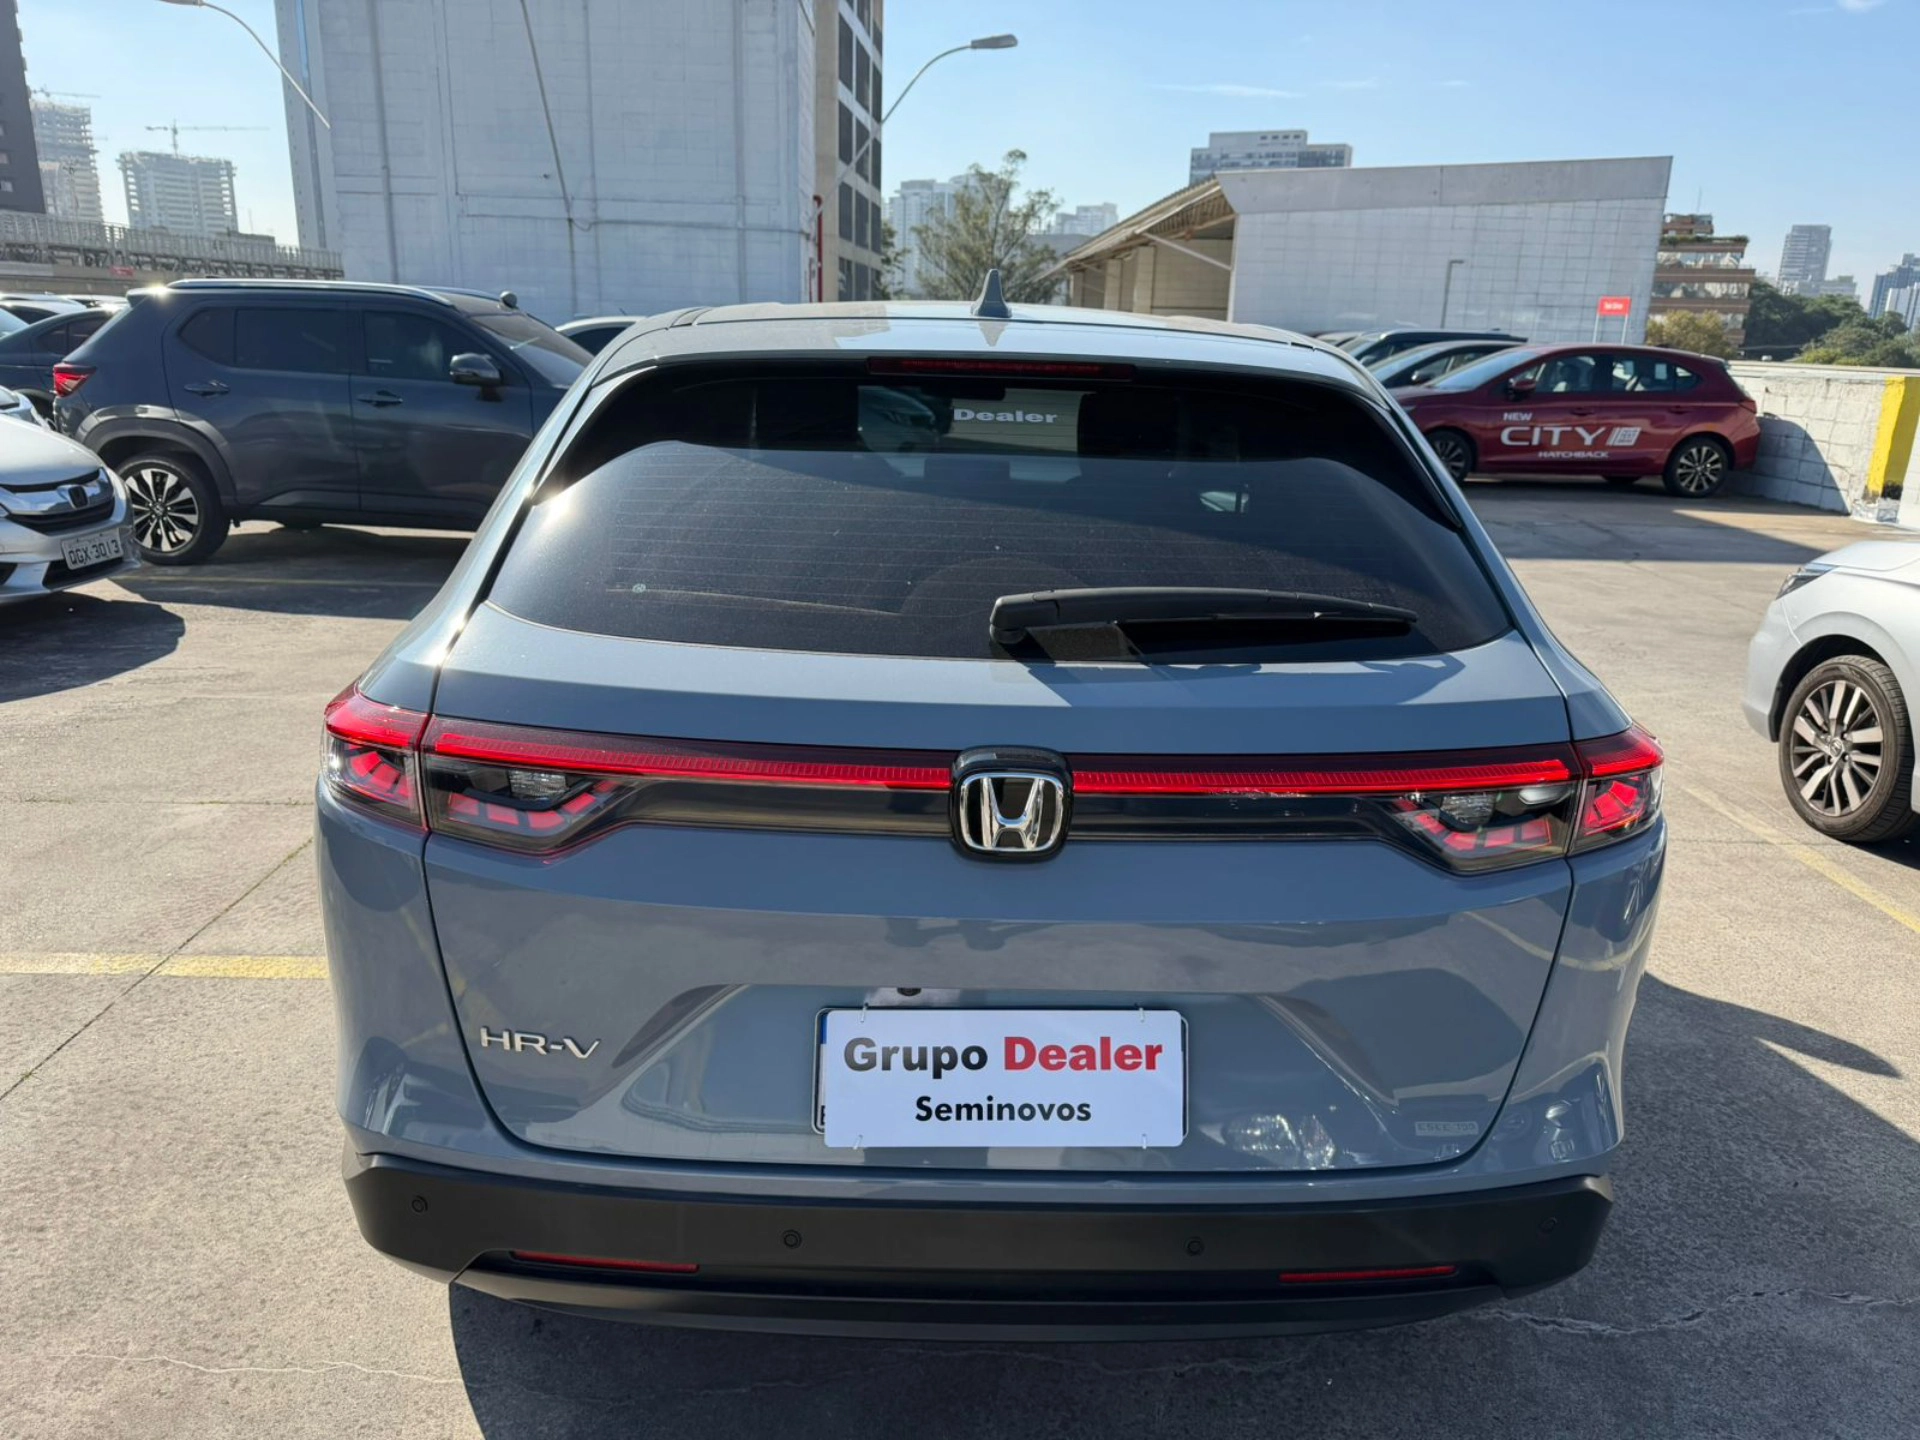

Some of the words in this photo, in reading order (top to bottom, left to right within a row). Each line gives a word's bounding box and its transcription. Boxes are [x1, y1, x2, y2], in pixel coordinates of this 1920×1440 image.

[953, 408, 1058, 424] Dealer
[1502, 412, 1533, 421] NEW
[1500, 426, 1606, 447] CITY
[1538, 451, 1610, 459] HATCHBACK
[480, 1026, 600, 1060] HR-V
[843, 1036, 988, 1080] Grupo
[1004, 1035, 1163, 1072] Dealer
[915, 1094, 1092, 1122] Seminovos
